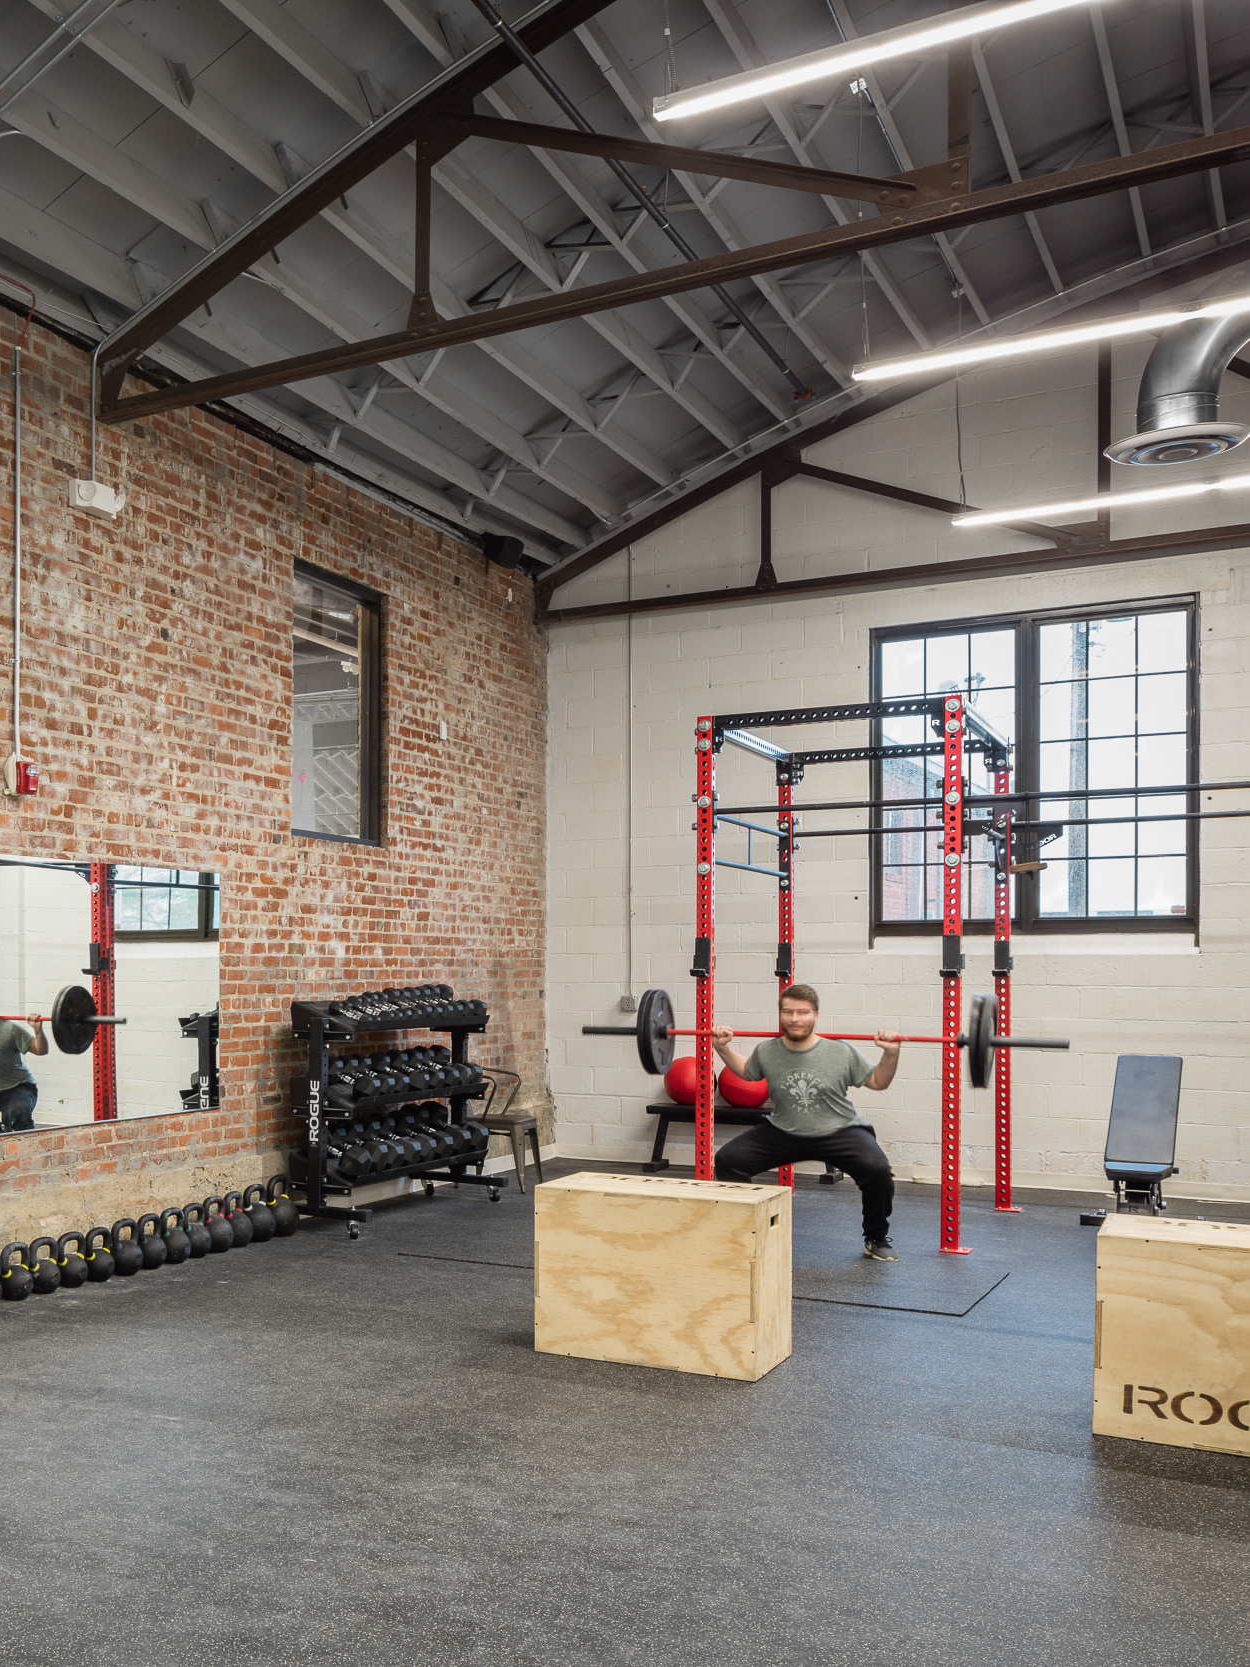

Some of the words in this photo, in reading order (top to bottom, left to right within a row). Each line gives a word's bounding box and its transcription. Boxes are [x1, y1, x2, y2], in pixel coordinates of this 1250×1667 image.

[931, 719, 941, 727] R
[780, 1072, 826, 1090] FLORENCE
[309, 1080, 320, 1142] ROGUE
[791, 1104, 821, 1114] ITALY
